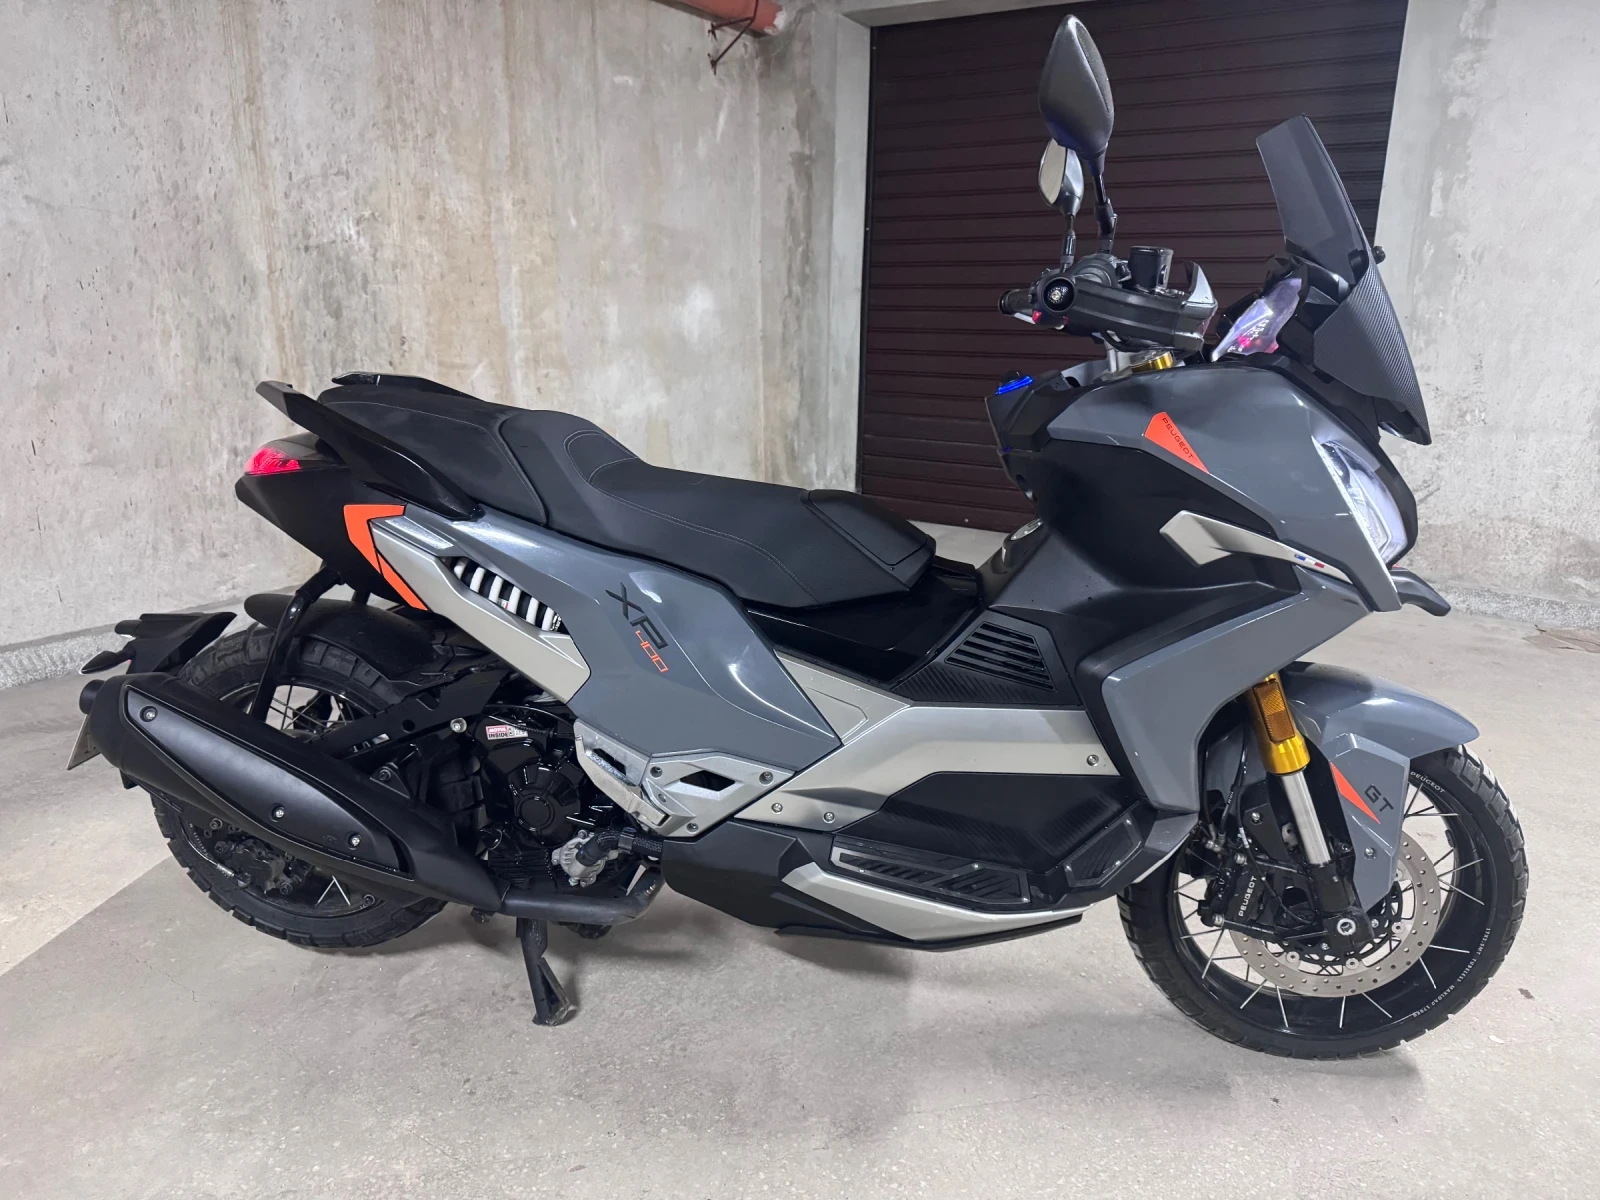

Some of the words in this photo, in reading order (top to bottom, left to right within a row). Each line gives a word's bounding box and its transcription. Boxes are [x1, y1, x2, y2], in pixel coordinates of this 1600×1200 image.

[1162, 417, 1194, 458] PEUGEOT
[605, 581, 669, 650] XP
[635, 630, 669, 673] 400
[1364, 784, 1394, 812] GT
[1410, 771, 1446, 793] PEUGEOT
[1238, 876, 1257, 917] PEUGEOT
